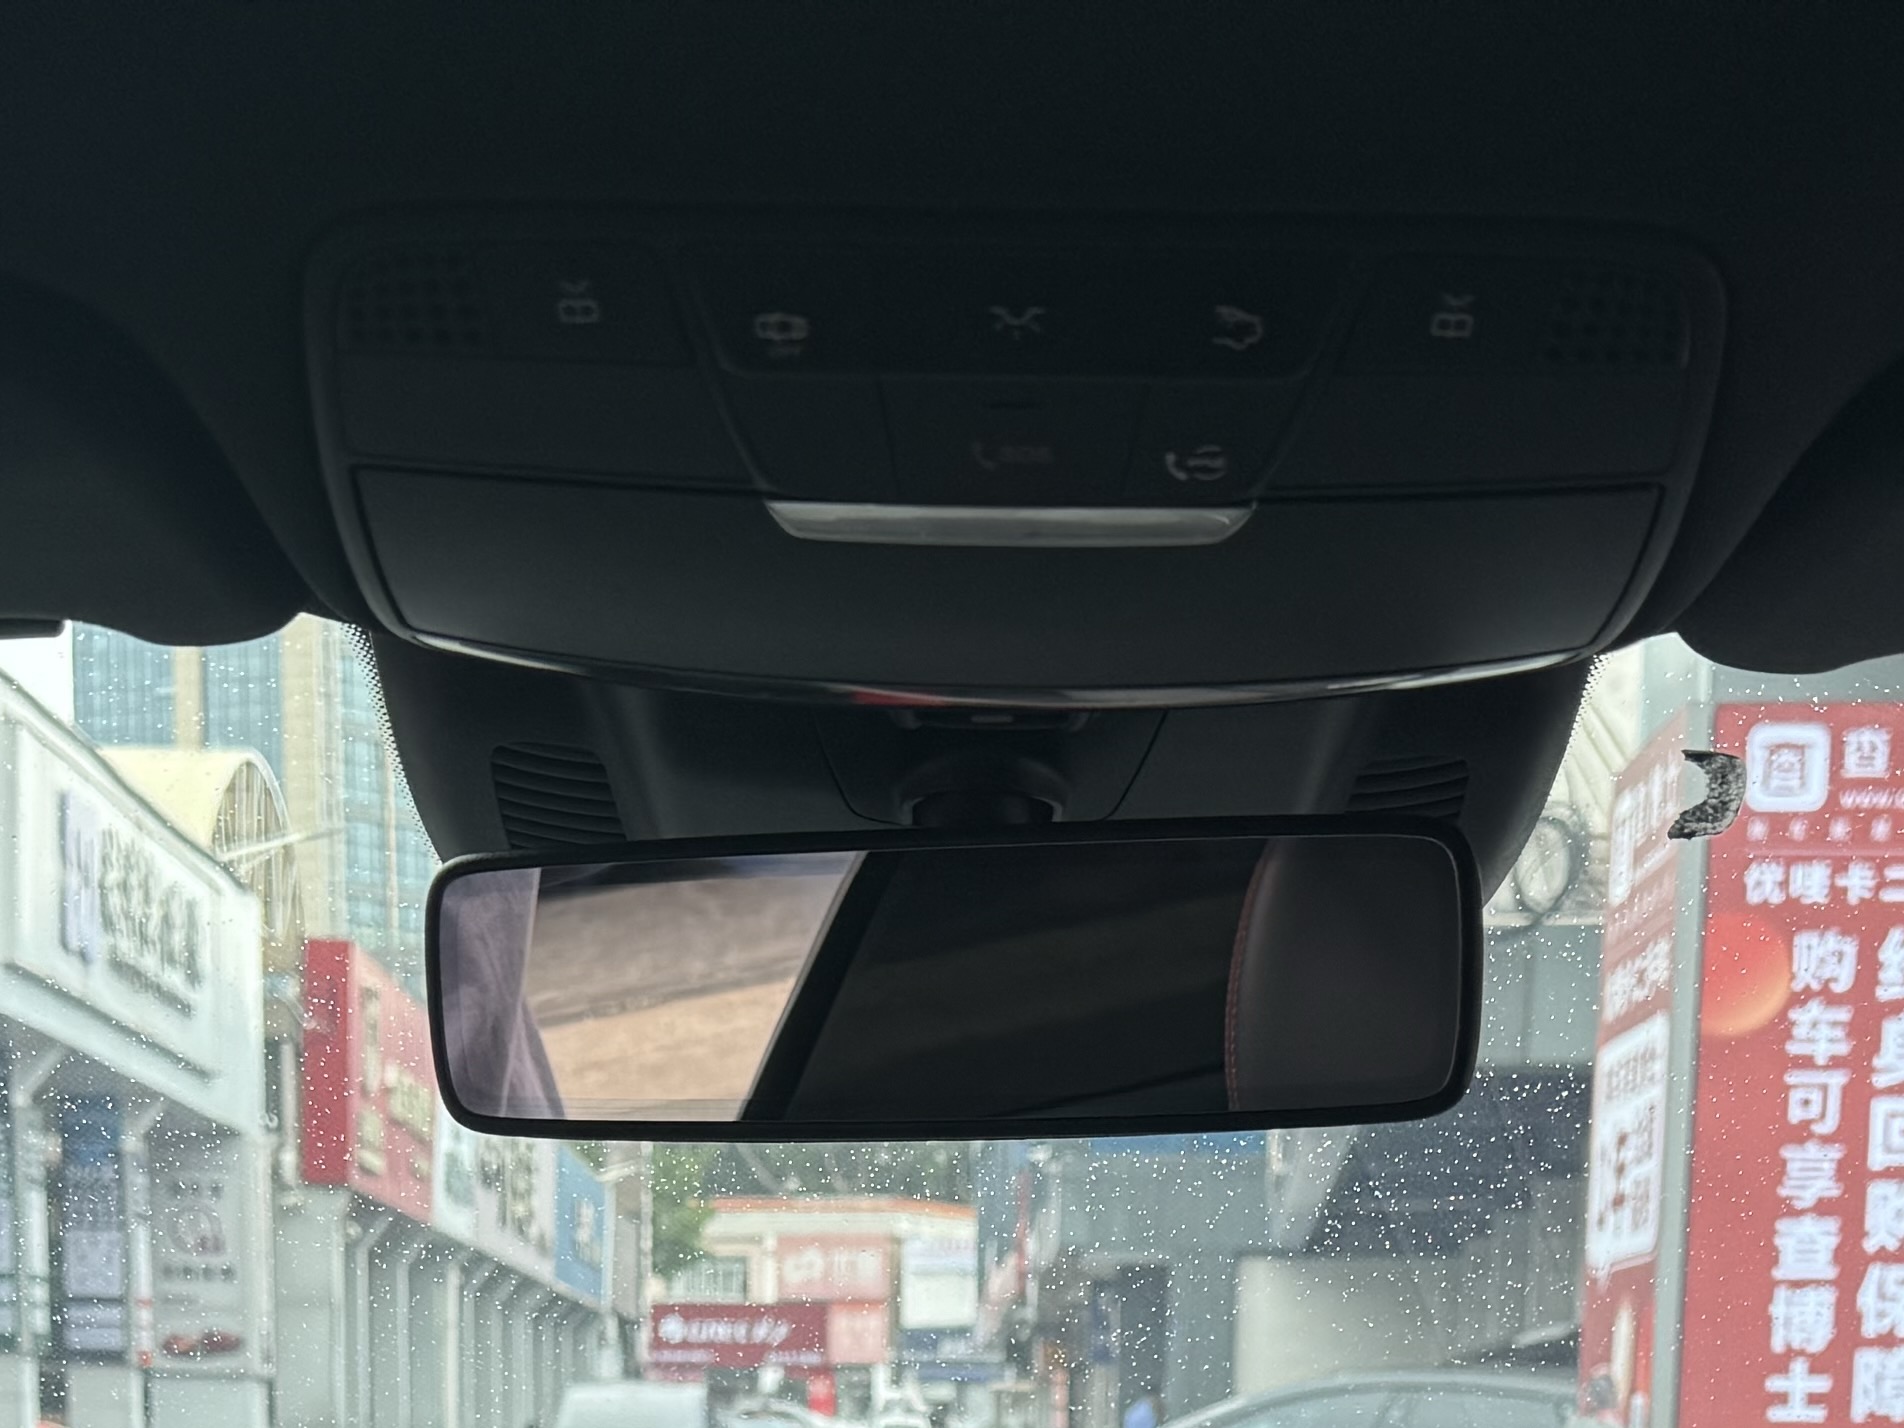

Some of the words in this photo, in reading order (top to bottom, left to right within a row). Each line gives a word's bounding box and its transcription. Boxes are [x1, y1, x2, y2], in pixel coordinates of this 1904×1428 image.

[1765, 928, 1859, 1424] 购车可享查博士
